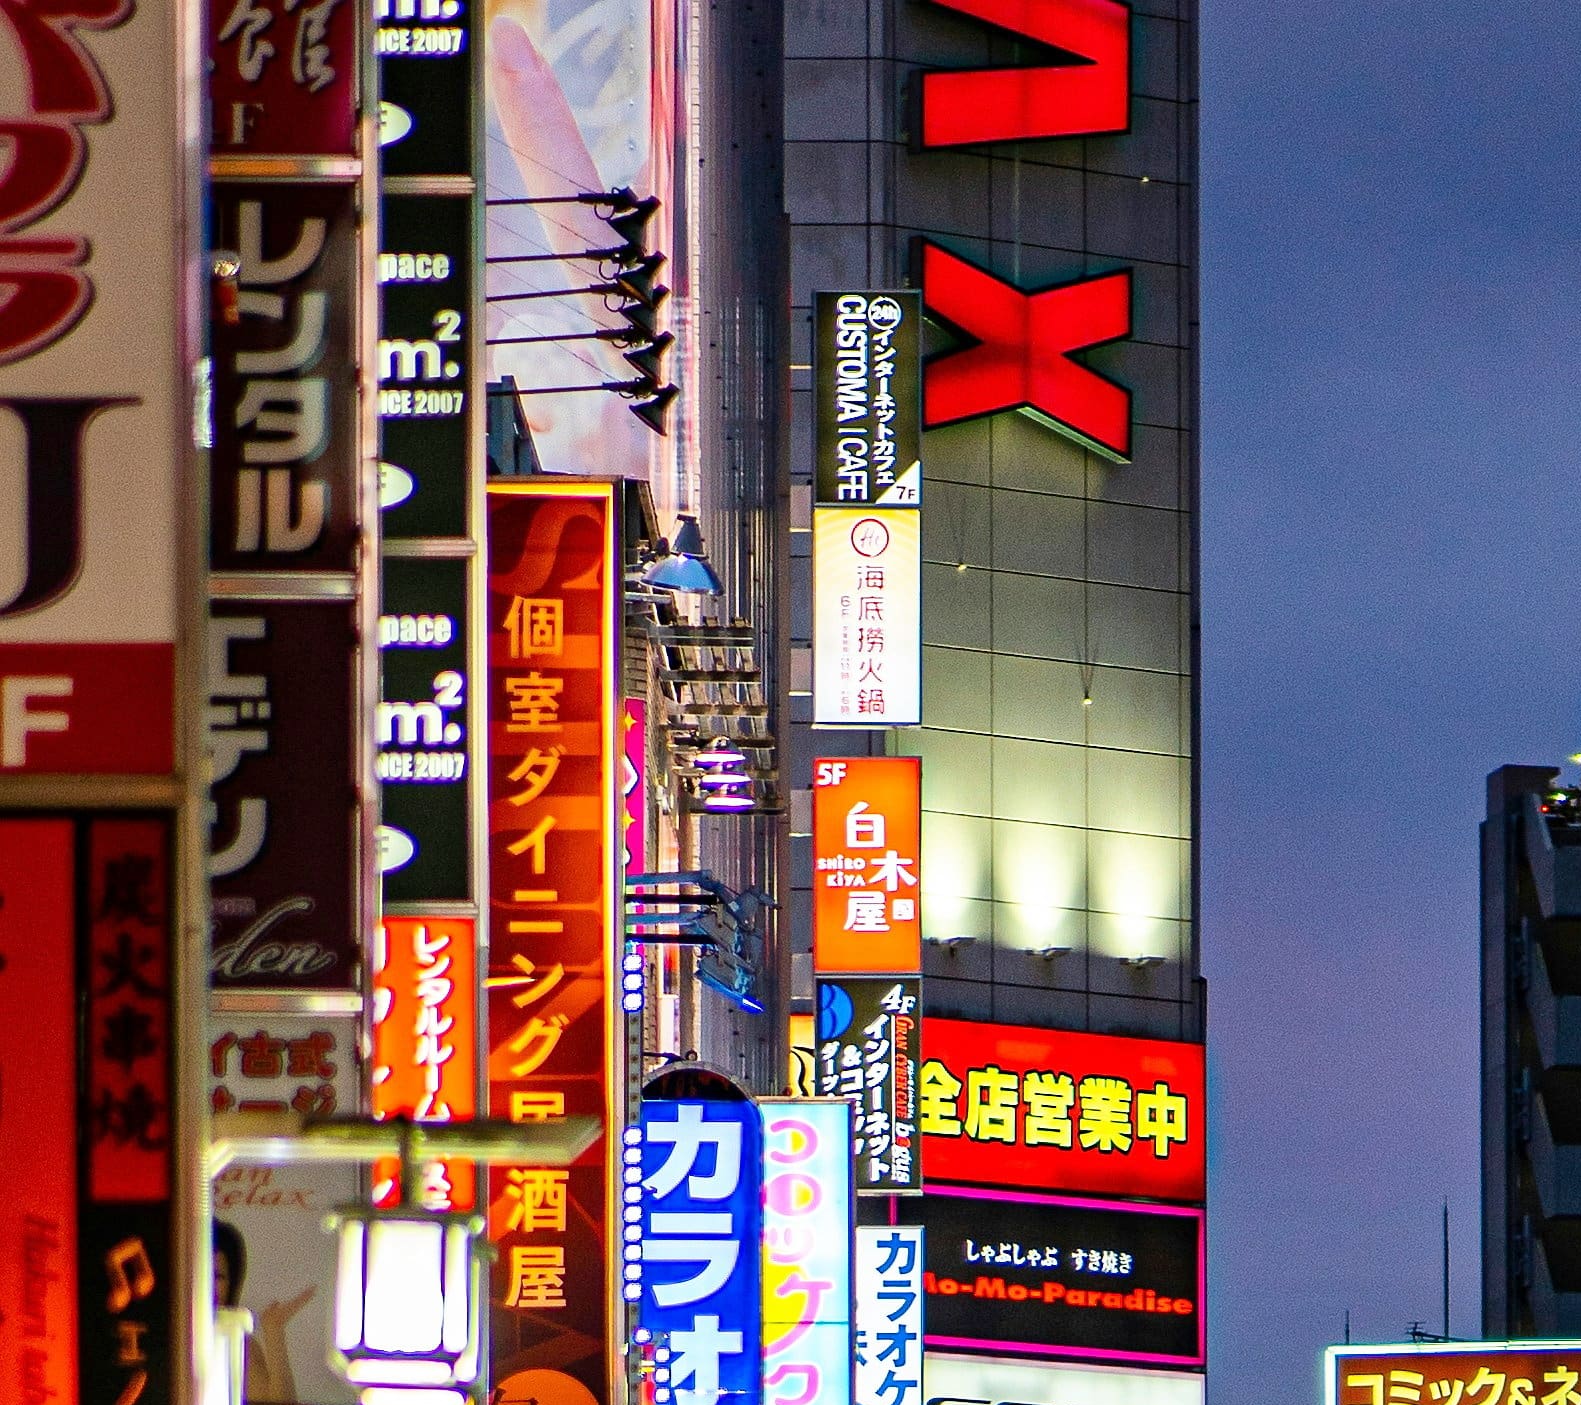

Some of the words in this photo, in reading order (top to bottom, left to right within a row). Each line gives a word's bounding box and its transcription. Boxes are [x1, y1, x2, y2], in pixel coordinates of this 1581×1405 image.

[837, 295, 868, 422] CUSTOMA
[873, 330, 897, 486] インターネットカフェ
[837, 437, 868, 500] CAFE
[896, 486, 916, 501] 7F
[857, 565, 886, 716] 海底撈火鍋
[415, 754, 464, 779] 2007
[816, 763, 846, 787] 5F
[881, 983, 916, 1015] 4F
[864, 1014, 890, 1183] インターネット
[922, 1060, 1189, 1160] 全店営業中
[965, 1237, 1058, 1268] しゃぶしゃぶ
[1071, 1247, 1133, 1275] すき焼き
